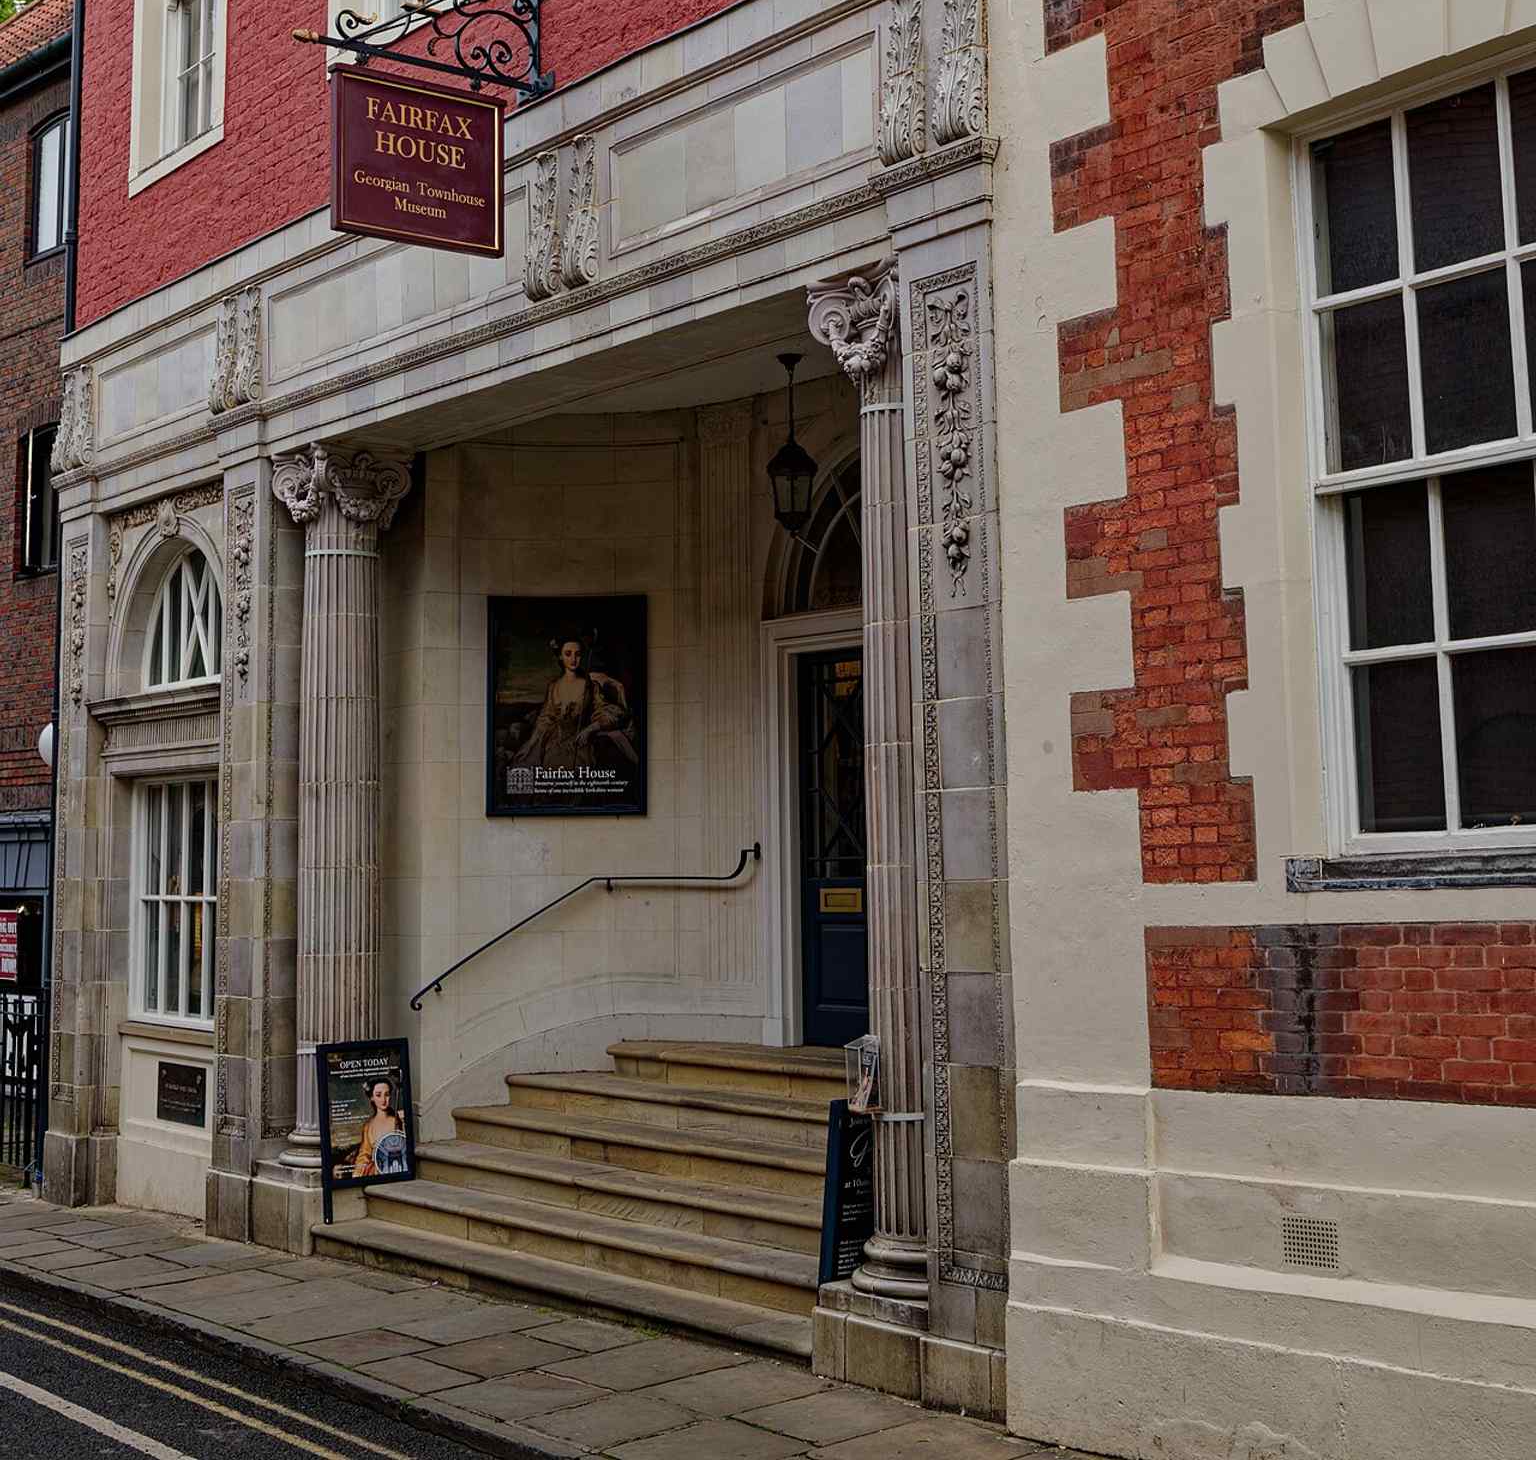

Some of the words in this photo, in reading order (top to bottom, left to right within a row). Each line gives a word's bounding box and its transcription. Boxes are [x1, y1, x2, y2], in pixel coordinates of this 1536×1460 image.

[366, 96, 474, 140] FAIRFAX
[375, 130, 466, 170] HOUSE
[354, 169, 410, 192] Georgian
[416, 181, 486, 208] Townhouse
[394, 195, 447, 219] Museum
[535, 765, 575, 779] Fairfax
[579, 766, 616, 779] House
[340, 1060, 362, 1069] OPEN
[363, 1057, 389, 1067] TODAY
